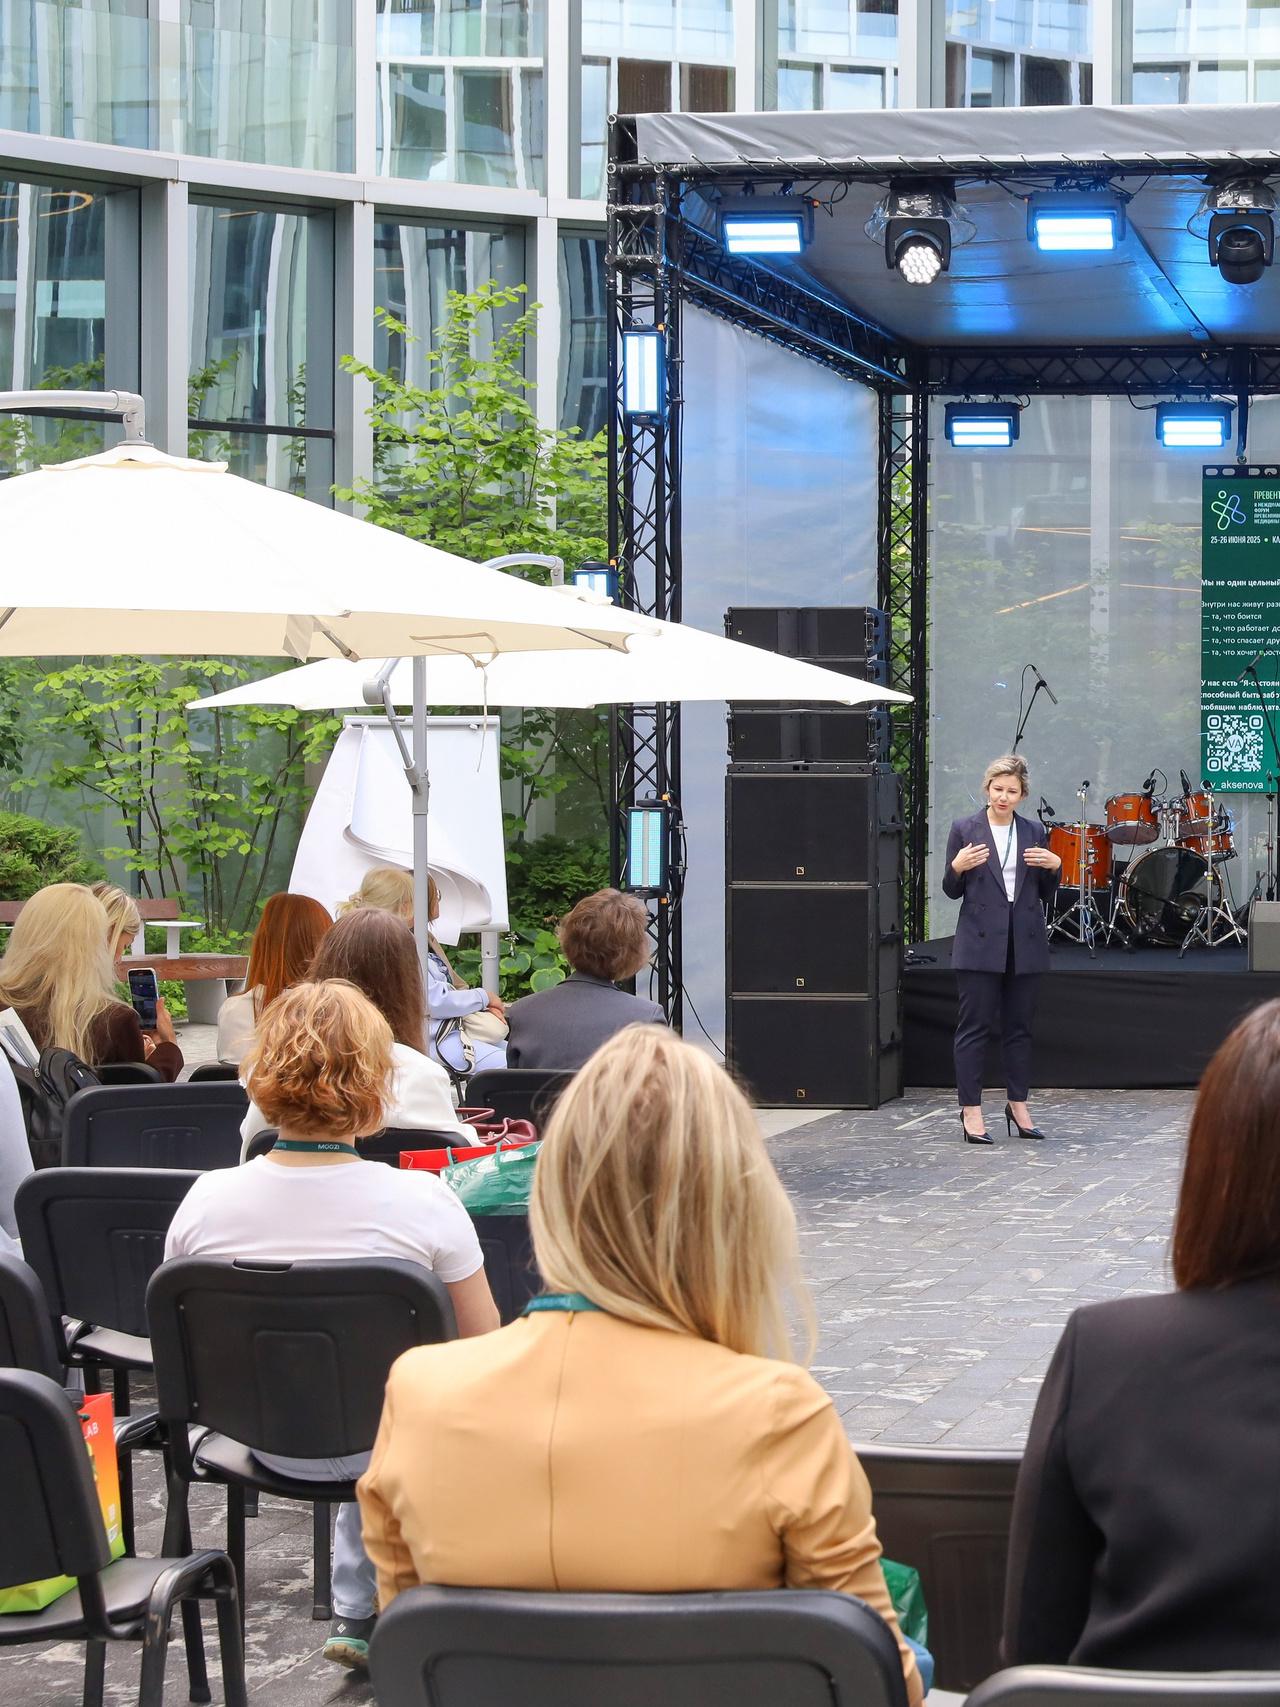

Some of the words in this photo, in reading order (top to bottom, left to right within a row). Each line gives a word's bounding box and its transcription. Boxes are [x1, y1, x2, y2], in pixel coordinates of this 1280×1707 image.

[1210, 536, 1228, 544] 25-26
[1228, 536, 1246, 544] ИЮНЯ
[1247, 536, 1261, 544] 2025
[1248, 579, 1280, 587] цельный
[84, 1422, 99, 1439] AB
